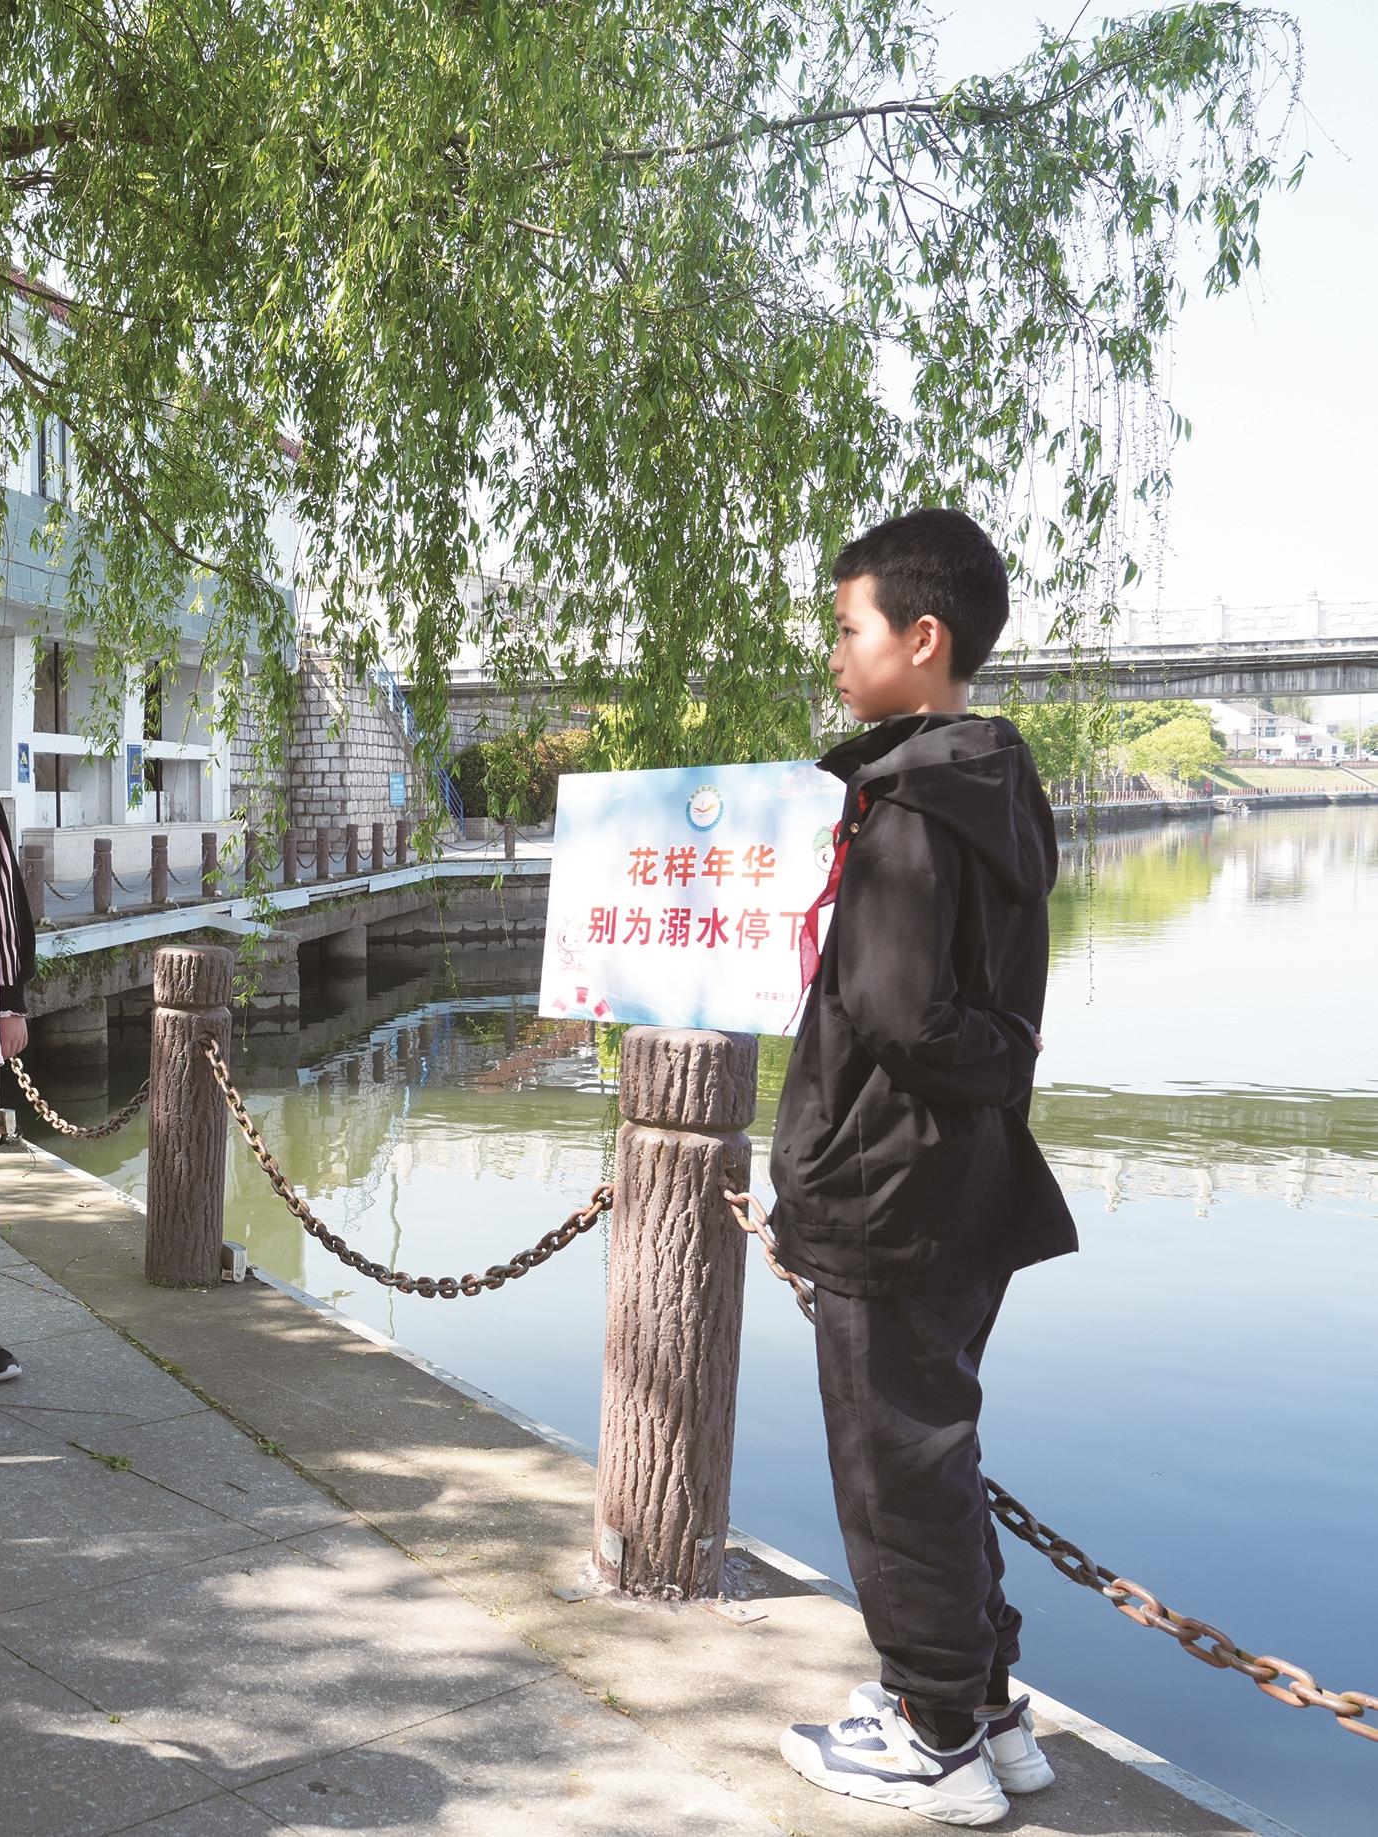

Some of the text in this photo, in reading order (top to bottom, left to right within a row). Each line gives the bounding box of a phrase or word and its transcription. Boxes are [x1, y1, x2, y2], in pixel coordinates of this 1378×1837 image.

[627, 844, 776, 887] 花样年华
[587, 906, 808, 951] 别为溺水停下
